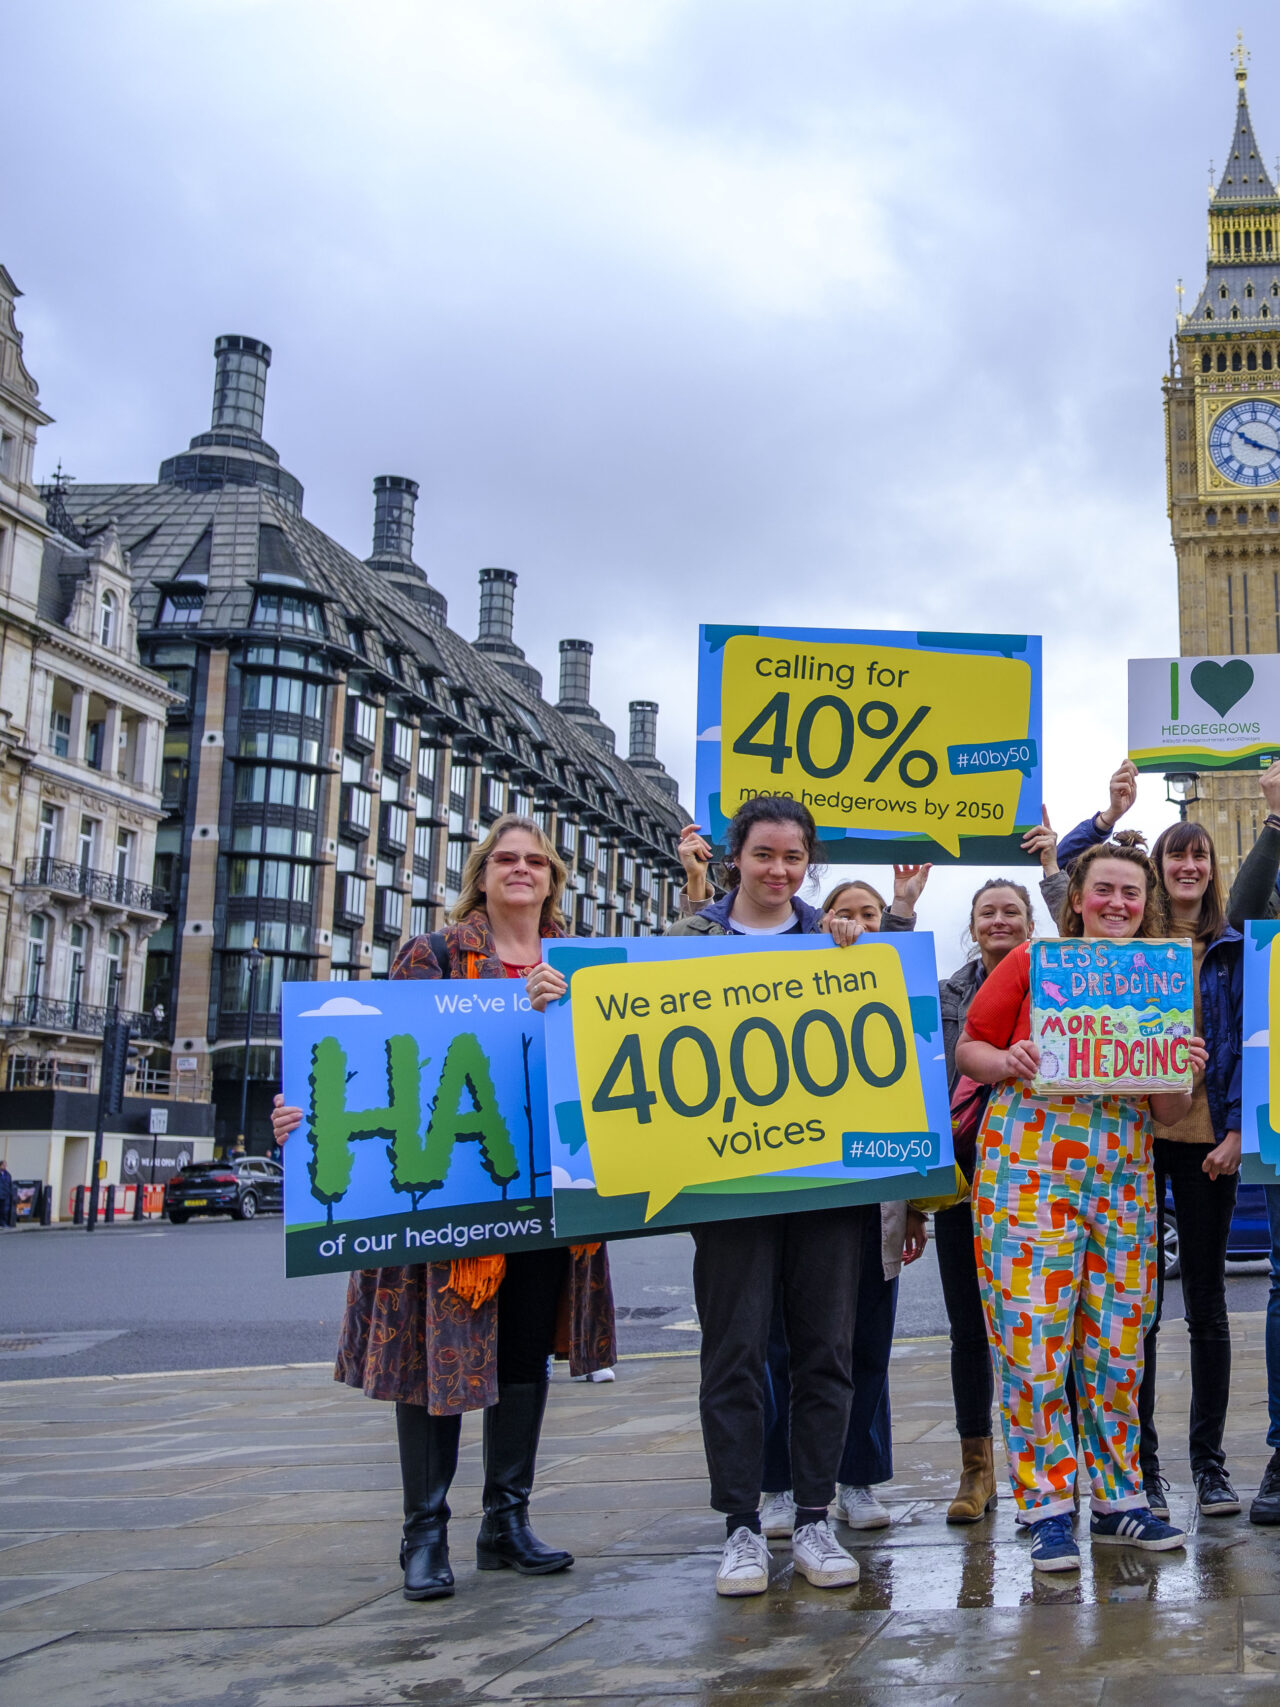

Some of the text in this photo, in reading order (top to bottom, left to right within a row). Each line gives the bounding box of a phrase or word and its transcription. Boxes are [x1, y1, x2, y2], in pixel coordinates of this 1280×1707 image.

[755, 654, 909, 690] calling for
[1170, 662, 1179, 720] I
[732, 691, 938, 789] 40%
[1161, 722, 1261, 736] HEDGEGROWS
[956, 745, 1030, 768] #40by50
[801, 788, 917, 815] hedgerows
[924, 798, 949, 821] by
[955, 801, 1004, 821] 2050
[1040, 944, 1109, 969] LESS
[596, 969, 877, 1021] We are more than
[1071, 971, 1186, 997] DREDGING
[513, 993, 532, 1012] lo
[1040, 1015, 1114, 1037] MORE
[591, 1001, 907, 1125] 40,000
[1068, 1037, 1190, 1078] HEDGING
[707, 1118, 825, 1158] voices
[849, 1138, 933, 1161] #40by50
[319, 1234, 346, 1257] of
[353, 1232, 397, 1254] our
[405, 1218, 542, 1248] hedgerows
